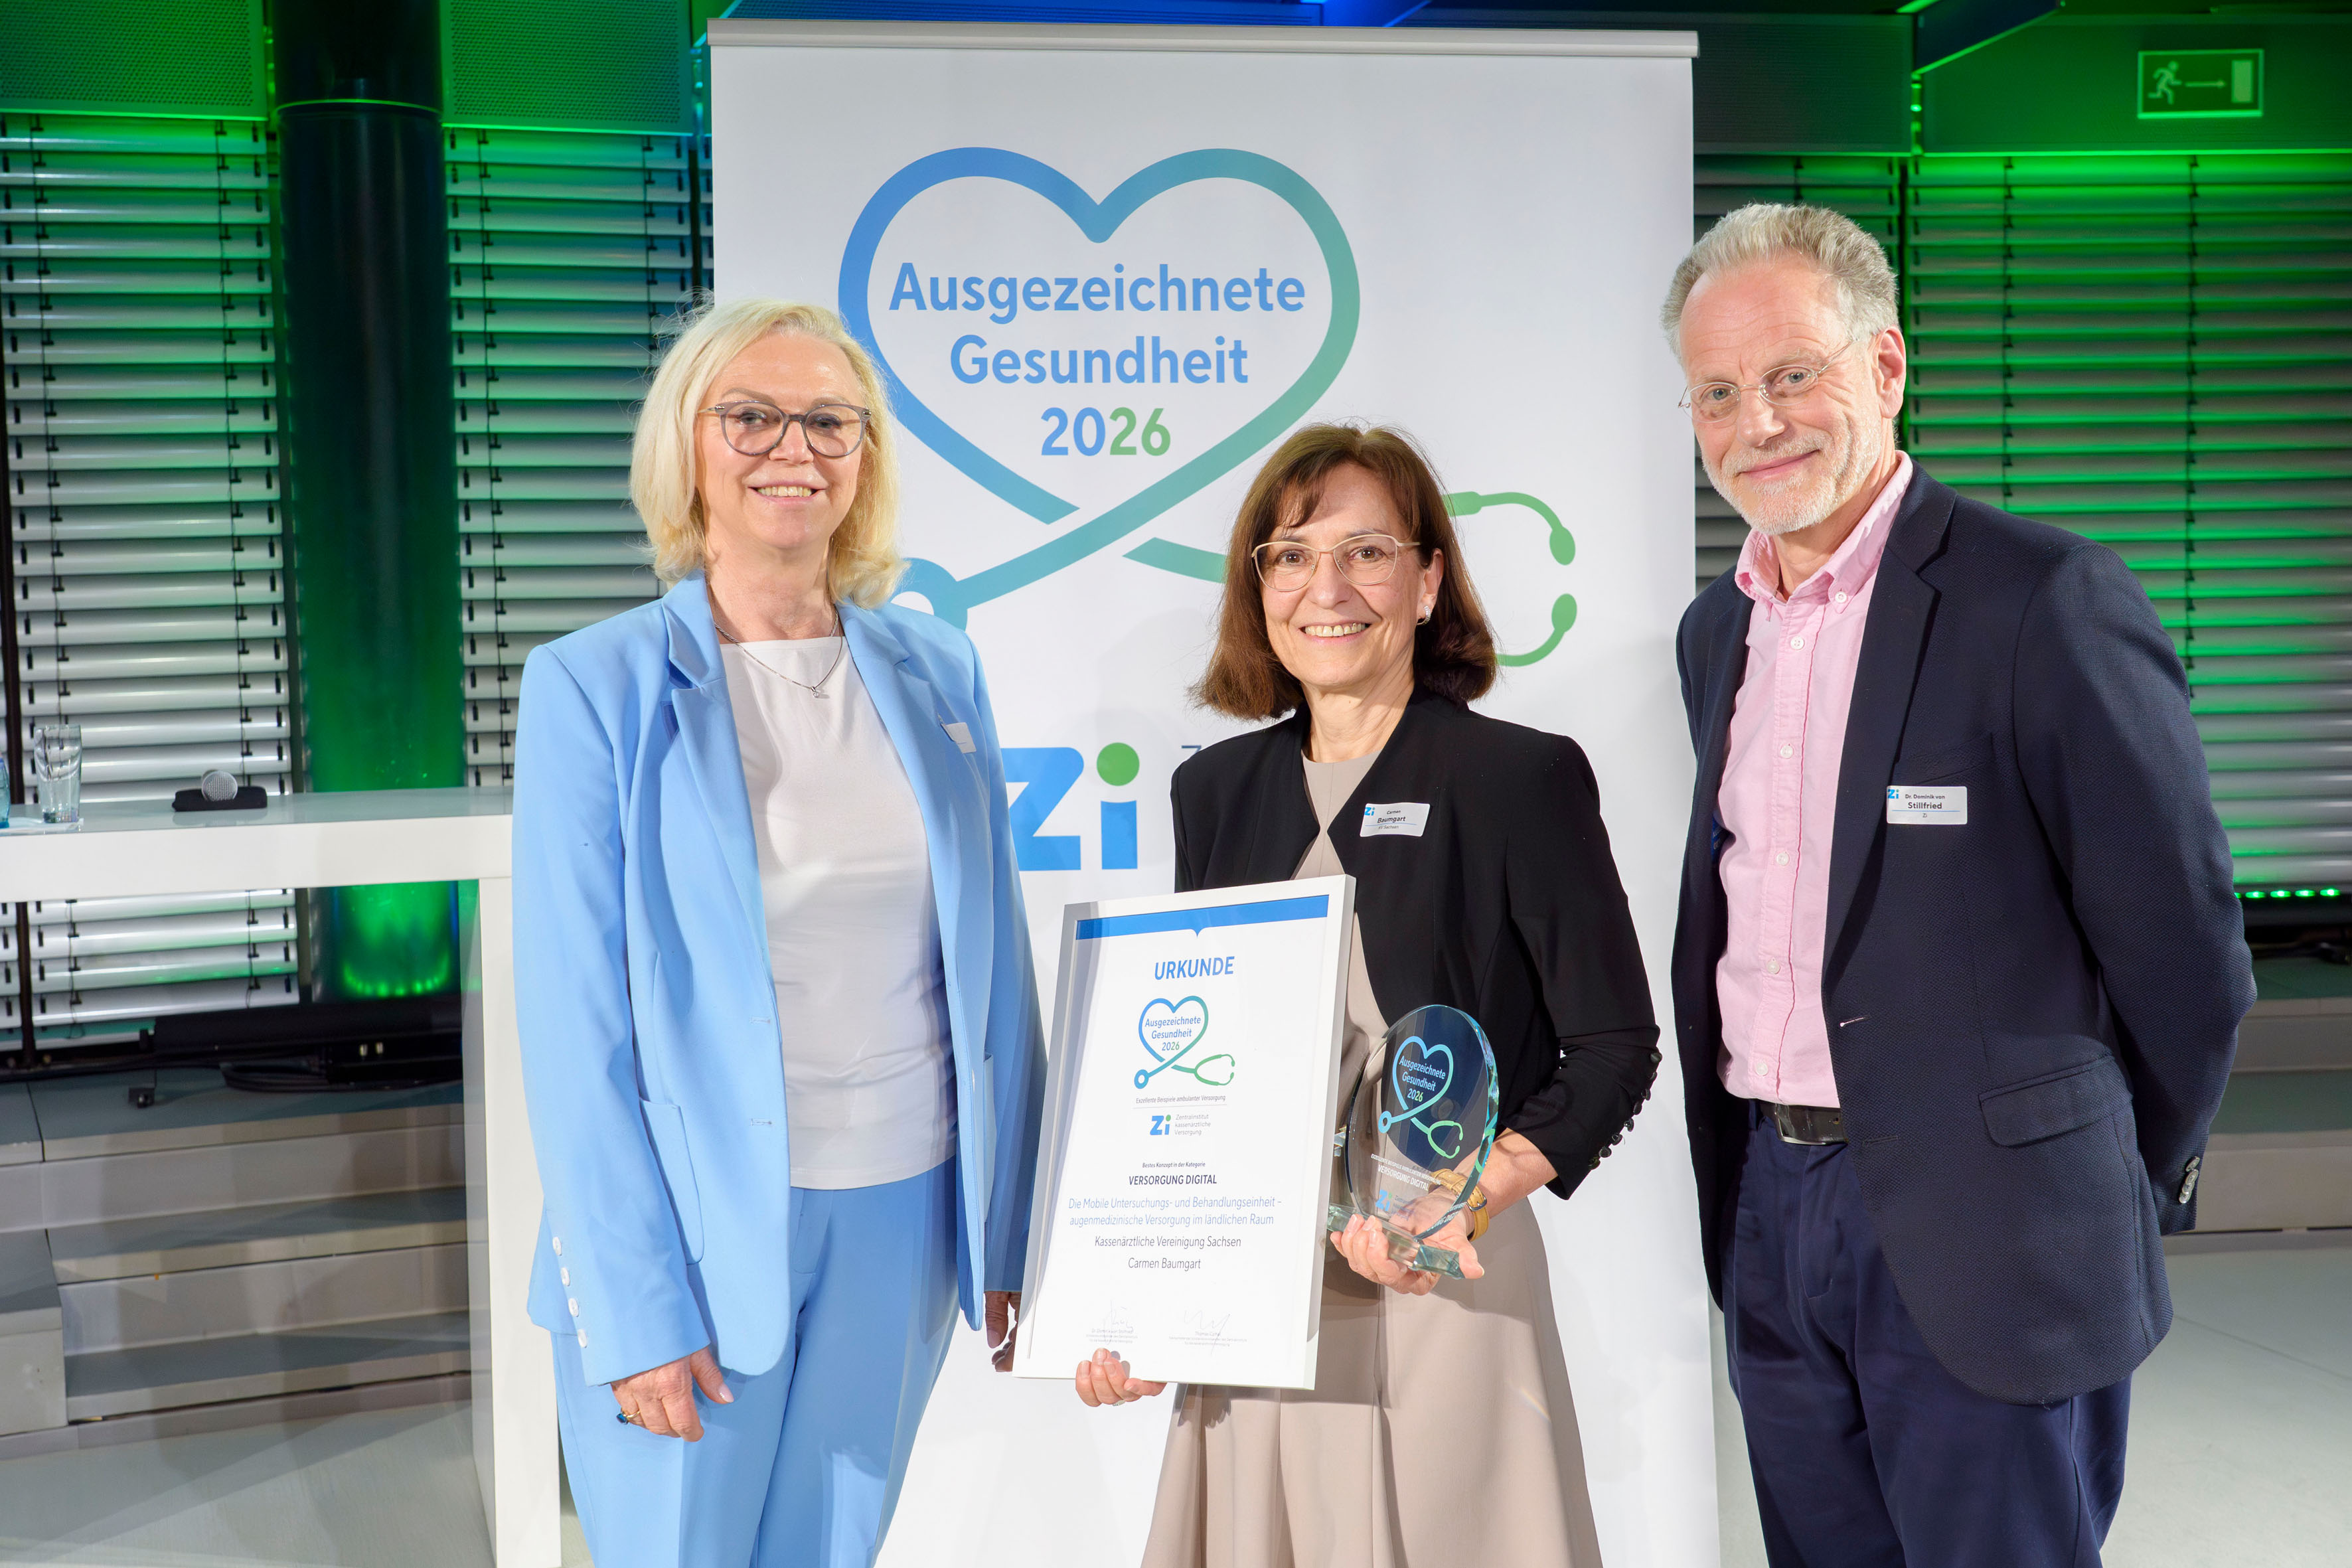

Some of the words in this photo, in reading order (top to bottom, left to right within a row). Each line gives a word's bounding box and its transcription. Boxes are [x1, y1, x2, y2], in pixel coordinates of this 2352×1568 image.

[889, 262, 1305, 325] Ausgezeichnete
[951, 334, 1249, 384] Gesundheit
[1041, 407, 1170, 456] 2026
[1888, 789, 1899, 799] Zi
[1364, 807, 1375, 816] Zi
[1154, 956, 1235, 980] URKUNDE
[1145, 1016, 1201, 1028] Ausgezeichnete
[1152, 1029, 1192, 1039] Gesundheit
[1162, 1042, 1180, 1051] 2026
[1399, 1056, 1446, 1079] Ausgezeichnete
[1402, 1071, 1436, 1091] Gesundheit
[1407, 1088, 1423, 1102] 2026
[1150, 1115, 1171, 1135] Zi
[1129, 1175, 1184, 1185] VERSORGUNG
[1186, 1174, 1217, 1184] DIGITAL
[1377, 1165, 1410, 1184] VERSORGUNG
[1411, 1178, 1429, 1191] DIGITAL
[1069, 1198, 1081, 1208] Die
[1083, 1198, 1109, 1208] Mobile
[1111, 1198, 1172, 1210] Untersuchungs-
[1175, 1197, 1190, 1208] und
[1193, 1196, 1275, 1210] Behandlungseinheit
[1375, 1190, 1392, 1211] Zi
[1069, 1214, 1142, 1227] augenmedizinische
[1145, 1214, 1190, 1227] Versorgung
[1193, 1214, 1202, 1224] im
[1205, 1214, 1247, 1224] ländlichen
[1250, 1214, 1274, 1224] Raum
[1095, 1235, 1155, 1247] Kassenärztliche
[1157, 1235, 1205, 1249] Vereinigung
[1207, 1235, 1241, 1247] Sachsen
[1129, 1257, 1159, 1269] Carmen
[1162, 1257, 1201, 1271] Baumgart
